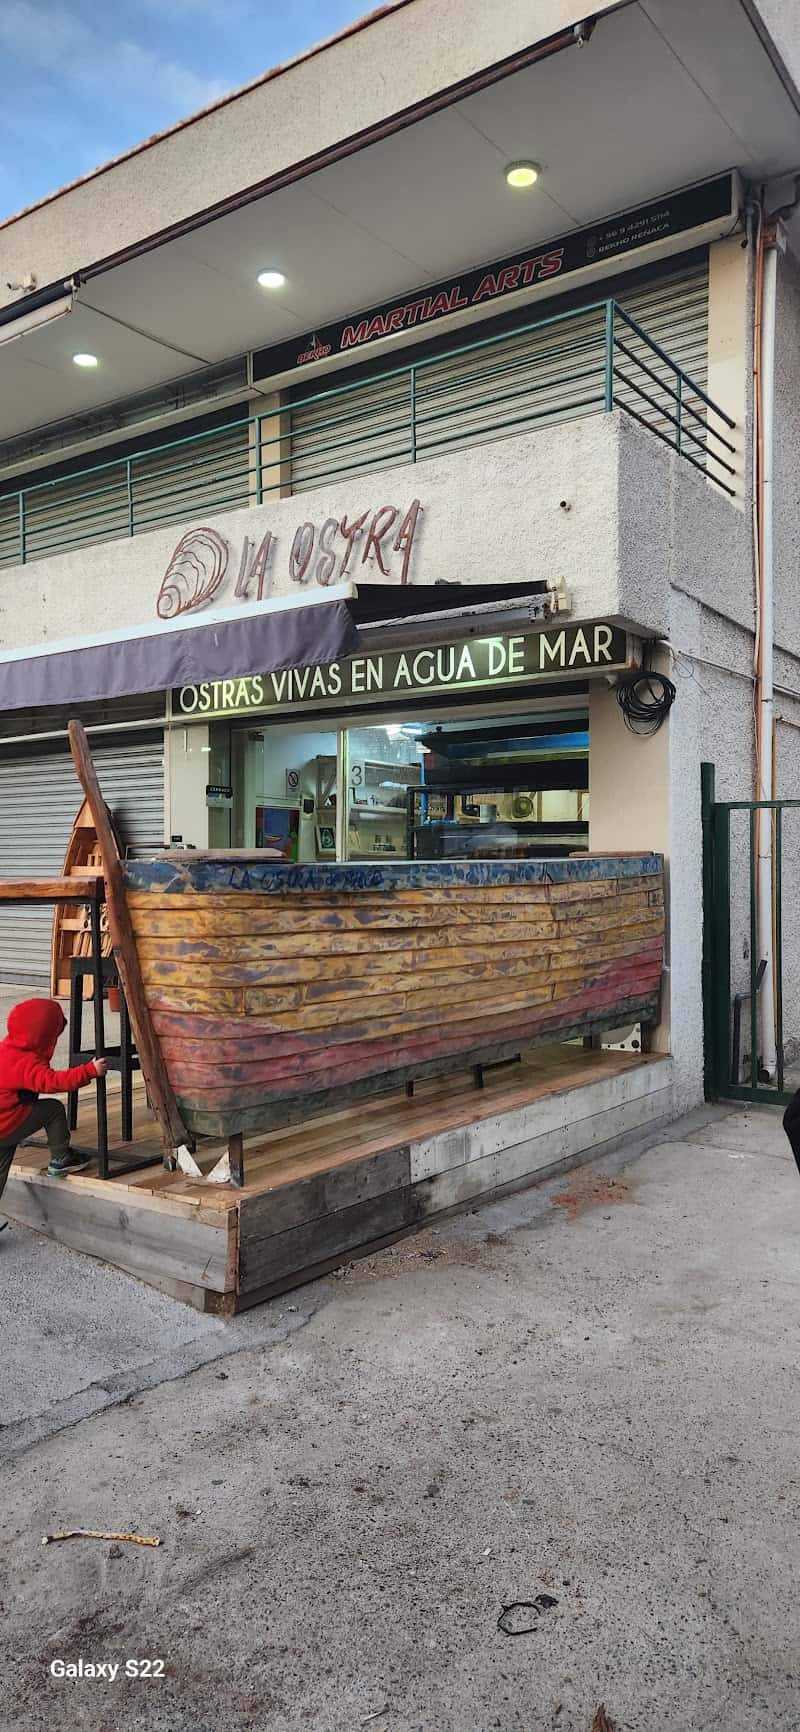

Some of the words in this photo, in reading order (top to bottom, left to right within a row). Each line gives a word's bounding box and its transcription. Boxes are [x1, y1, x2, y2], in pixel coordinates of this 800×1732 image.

[340, 287, 468, 349] MARTIAL
[472, 248, 565, 301] ARTS
[234, 530, 273, 600] LA
[289, 499, 421, 586] OSTRA
[179, 676, 264, 713] OSTRAS
[270, 662, 342, 702] VIVAS
[351, 658, 383, 692] EN
[393, 644, 475, 687] AGUA
[488, 637, 525, 675] DE
[539, 624, 614, 667] MAR
[351, 765, 362, 785] 3
[229, 867, 250, 889] LA
